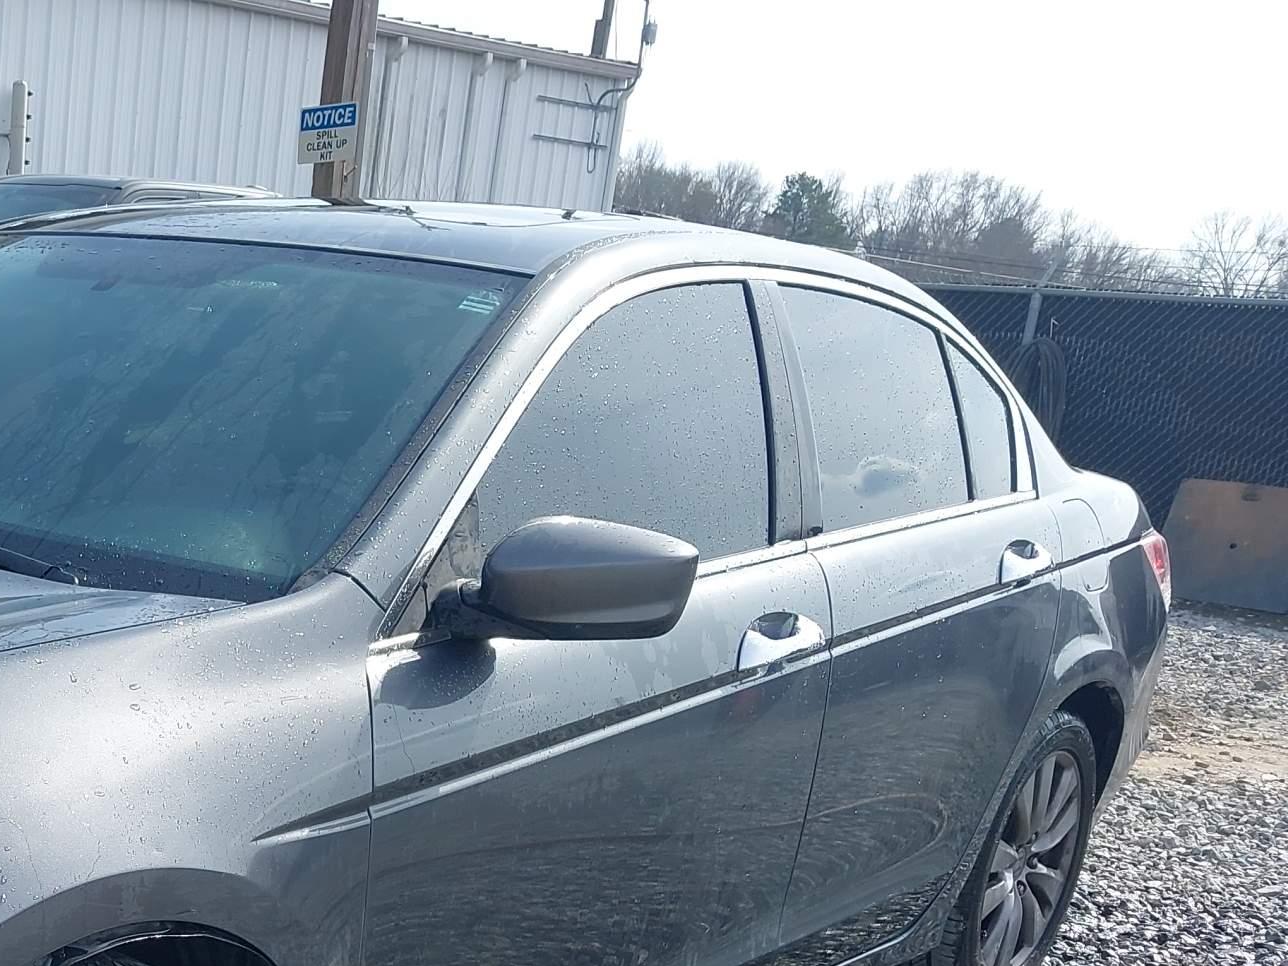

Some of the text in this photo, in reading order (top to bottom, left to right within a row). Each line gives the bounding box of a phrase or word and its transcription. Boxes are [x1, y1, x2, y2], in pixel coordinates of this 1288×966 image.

[303, 107, 354, 129] NOTICE
[316, 129, 338, 140] SPILL
[306, 138, 348, 151] CLEAN UP
[319, 151, 333, 161] KIT
